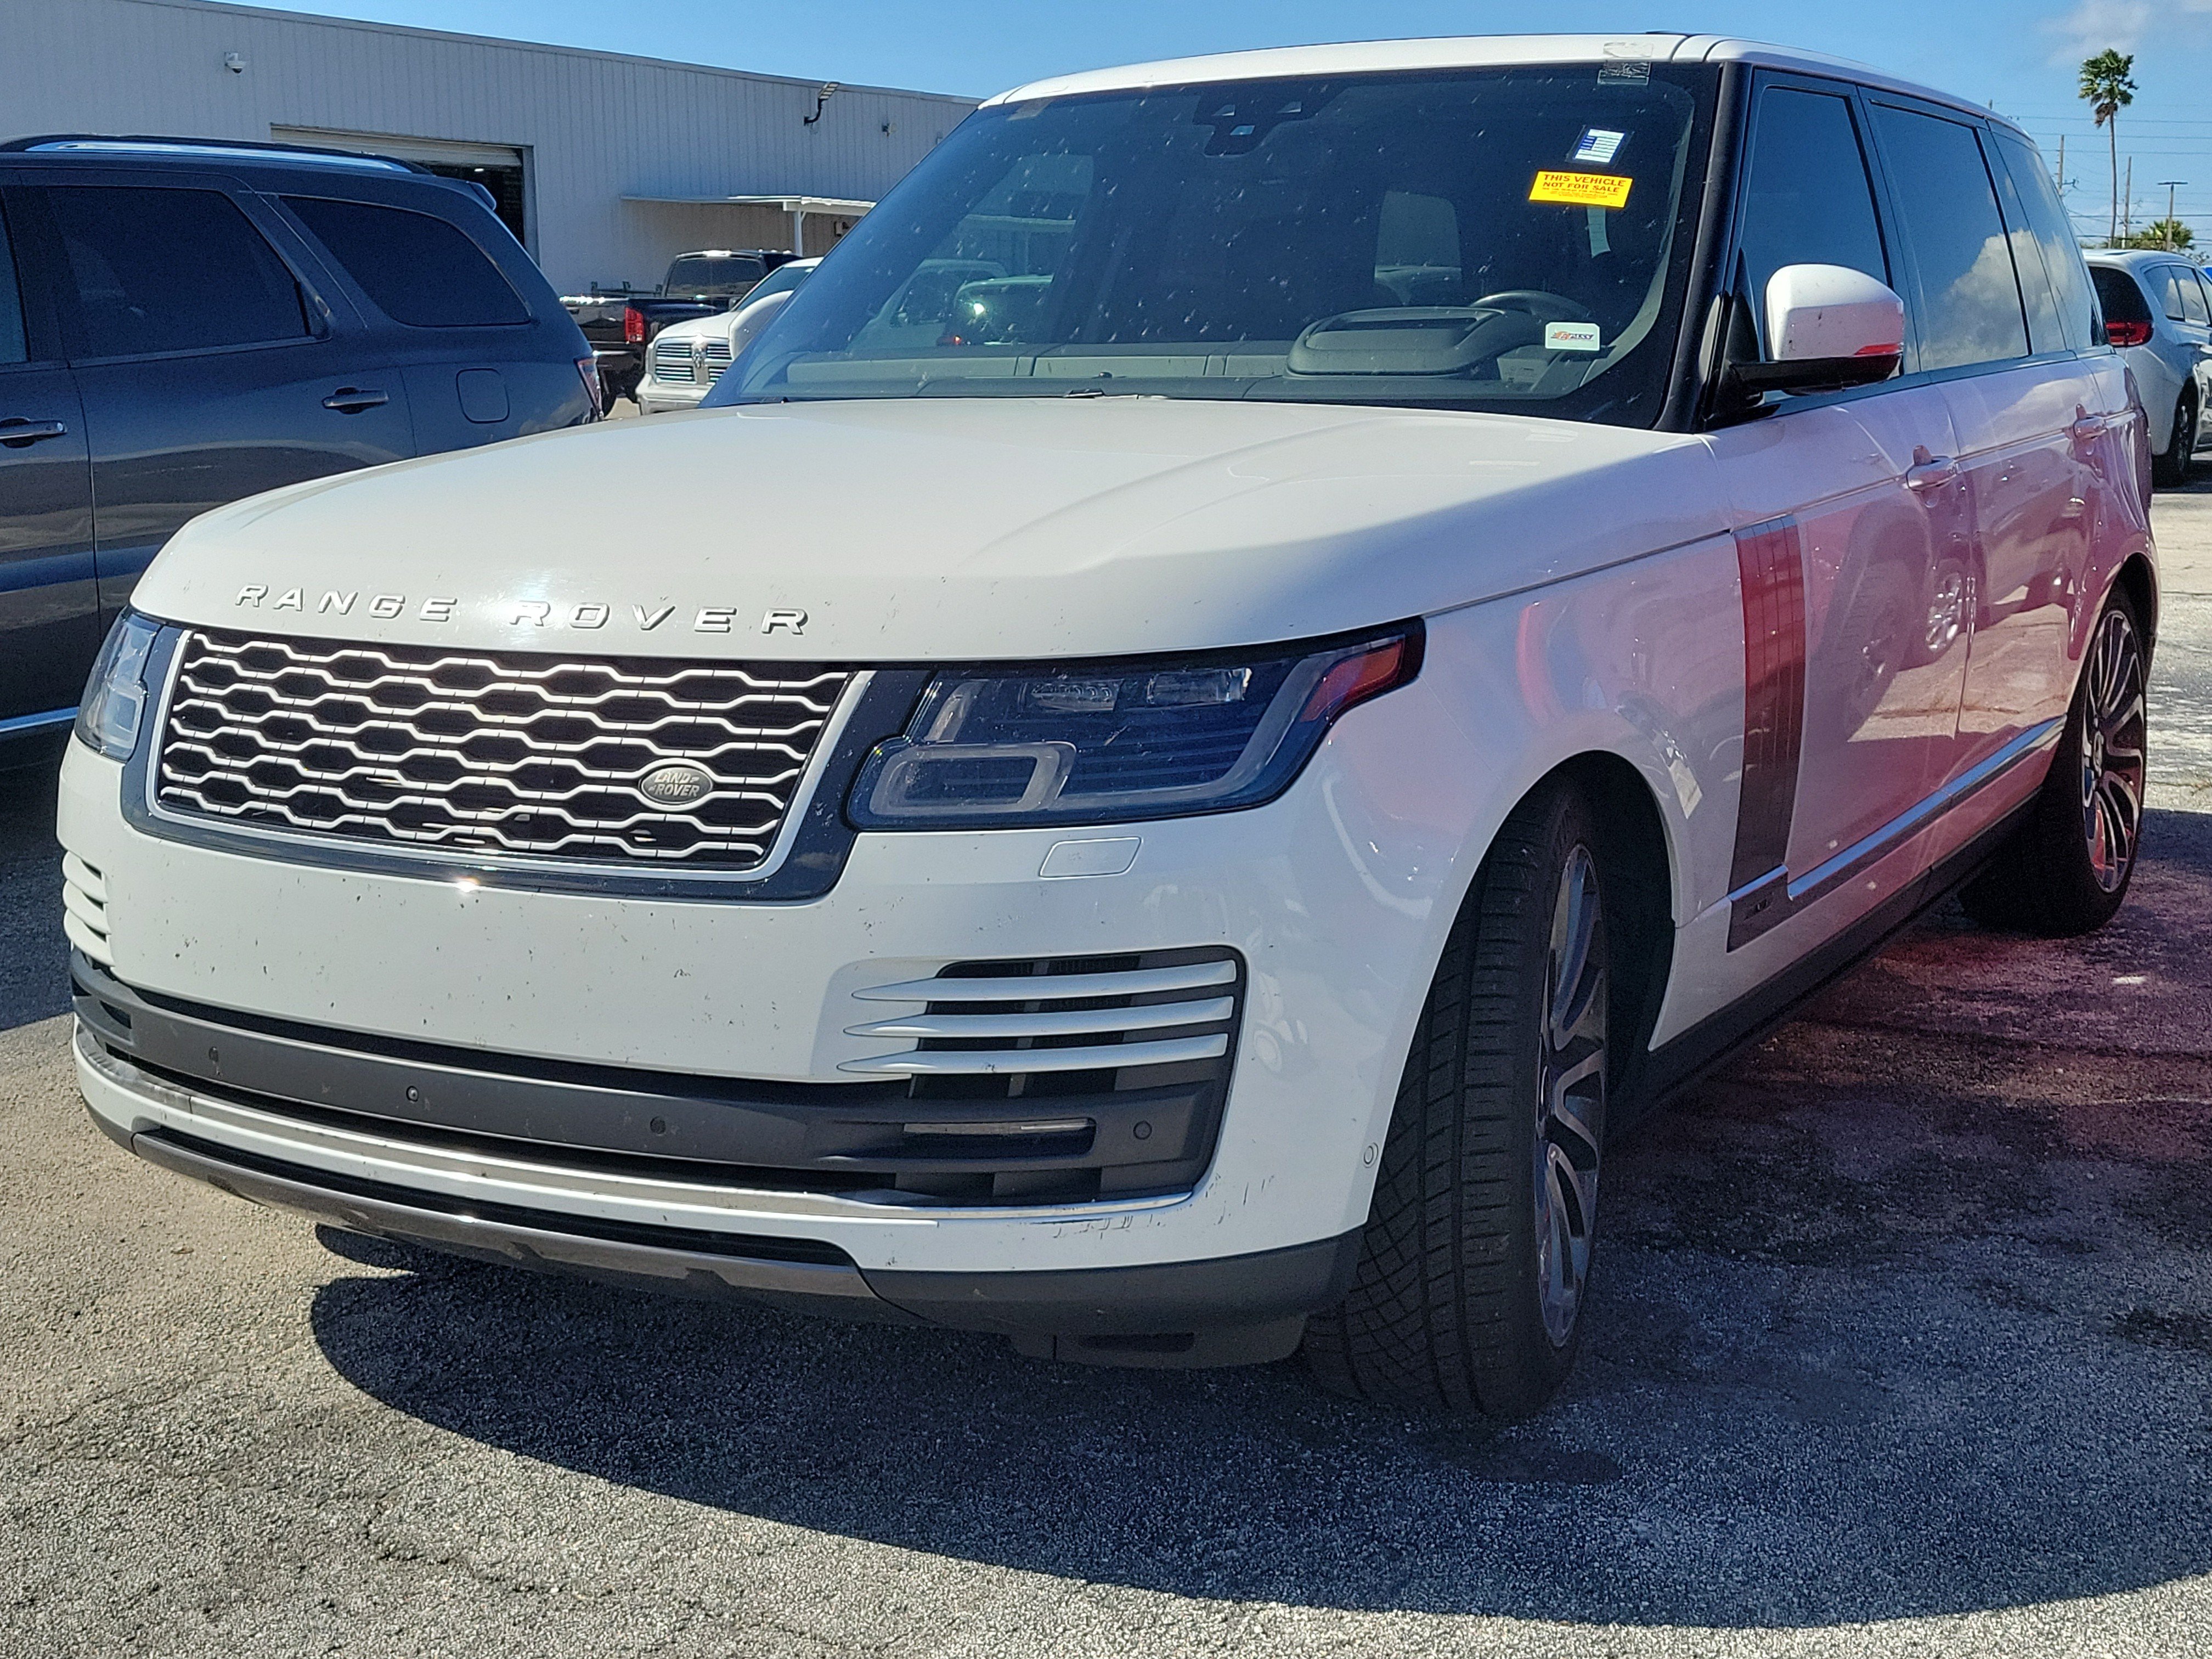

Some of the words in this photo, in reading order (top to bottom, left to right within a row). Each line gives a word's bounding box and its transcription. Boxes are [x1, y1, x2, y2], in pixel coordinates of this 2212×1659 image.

[1574, 176, 1626, 187] VEHICLE
[235, 584, 458, 622] RANGE
[509, 601, 808, 635] ROVER
[654, 771, 691, 784] LAND
[654, 783, 700, 797] ROVER
